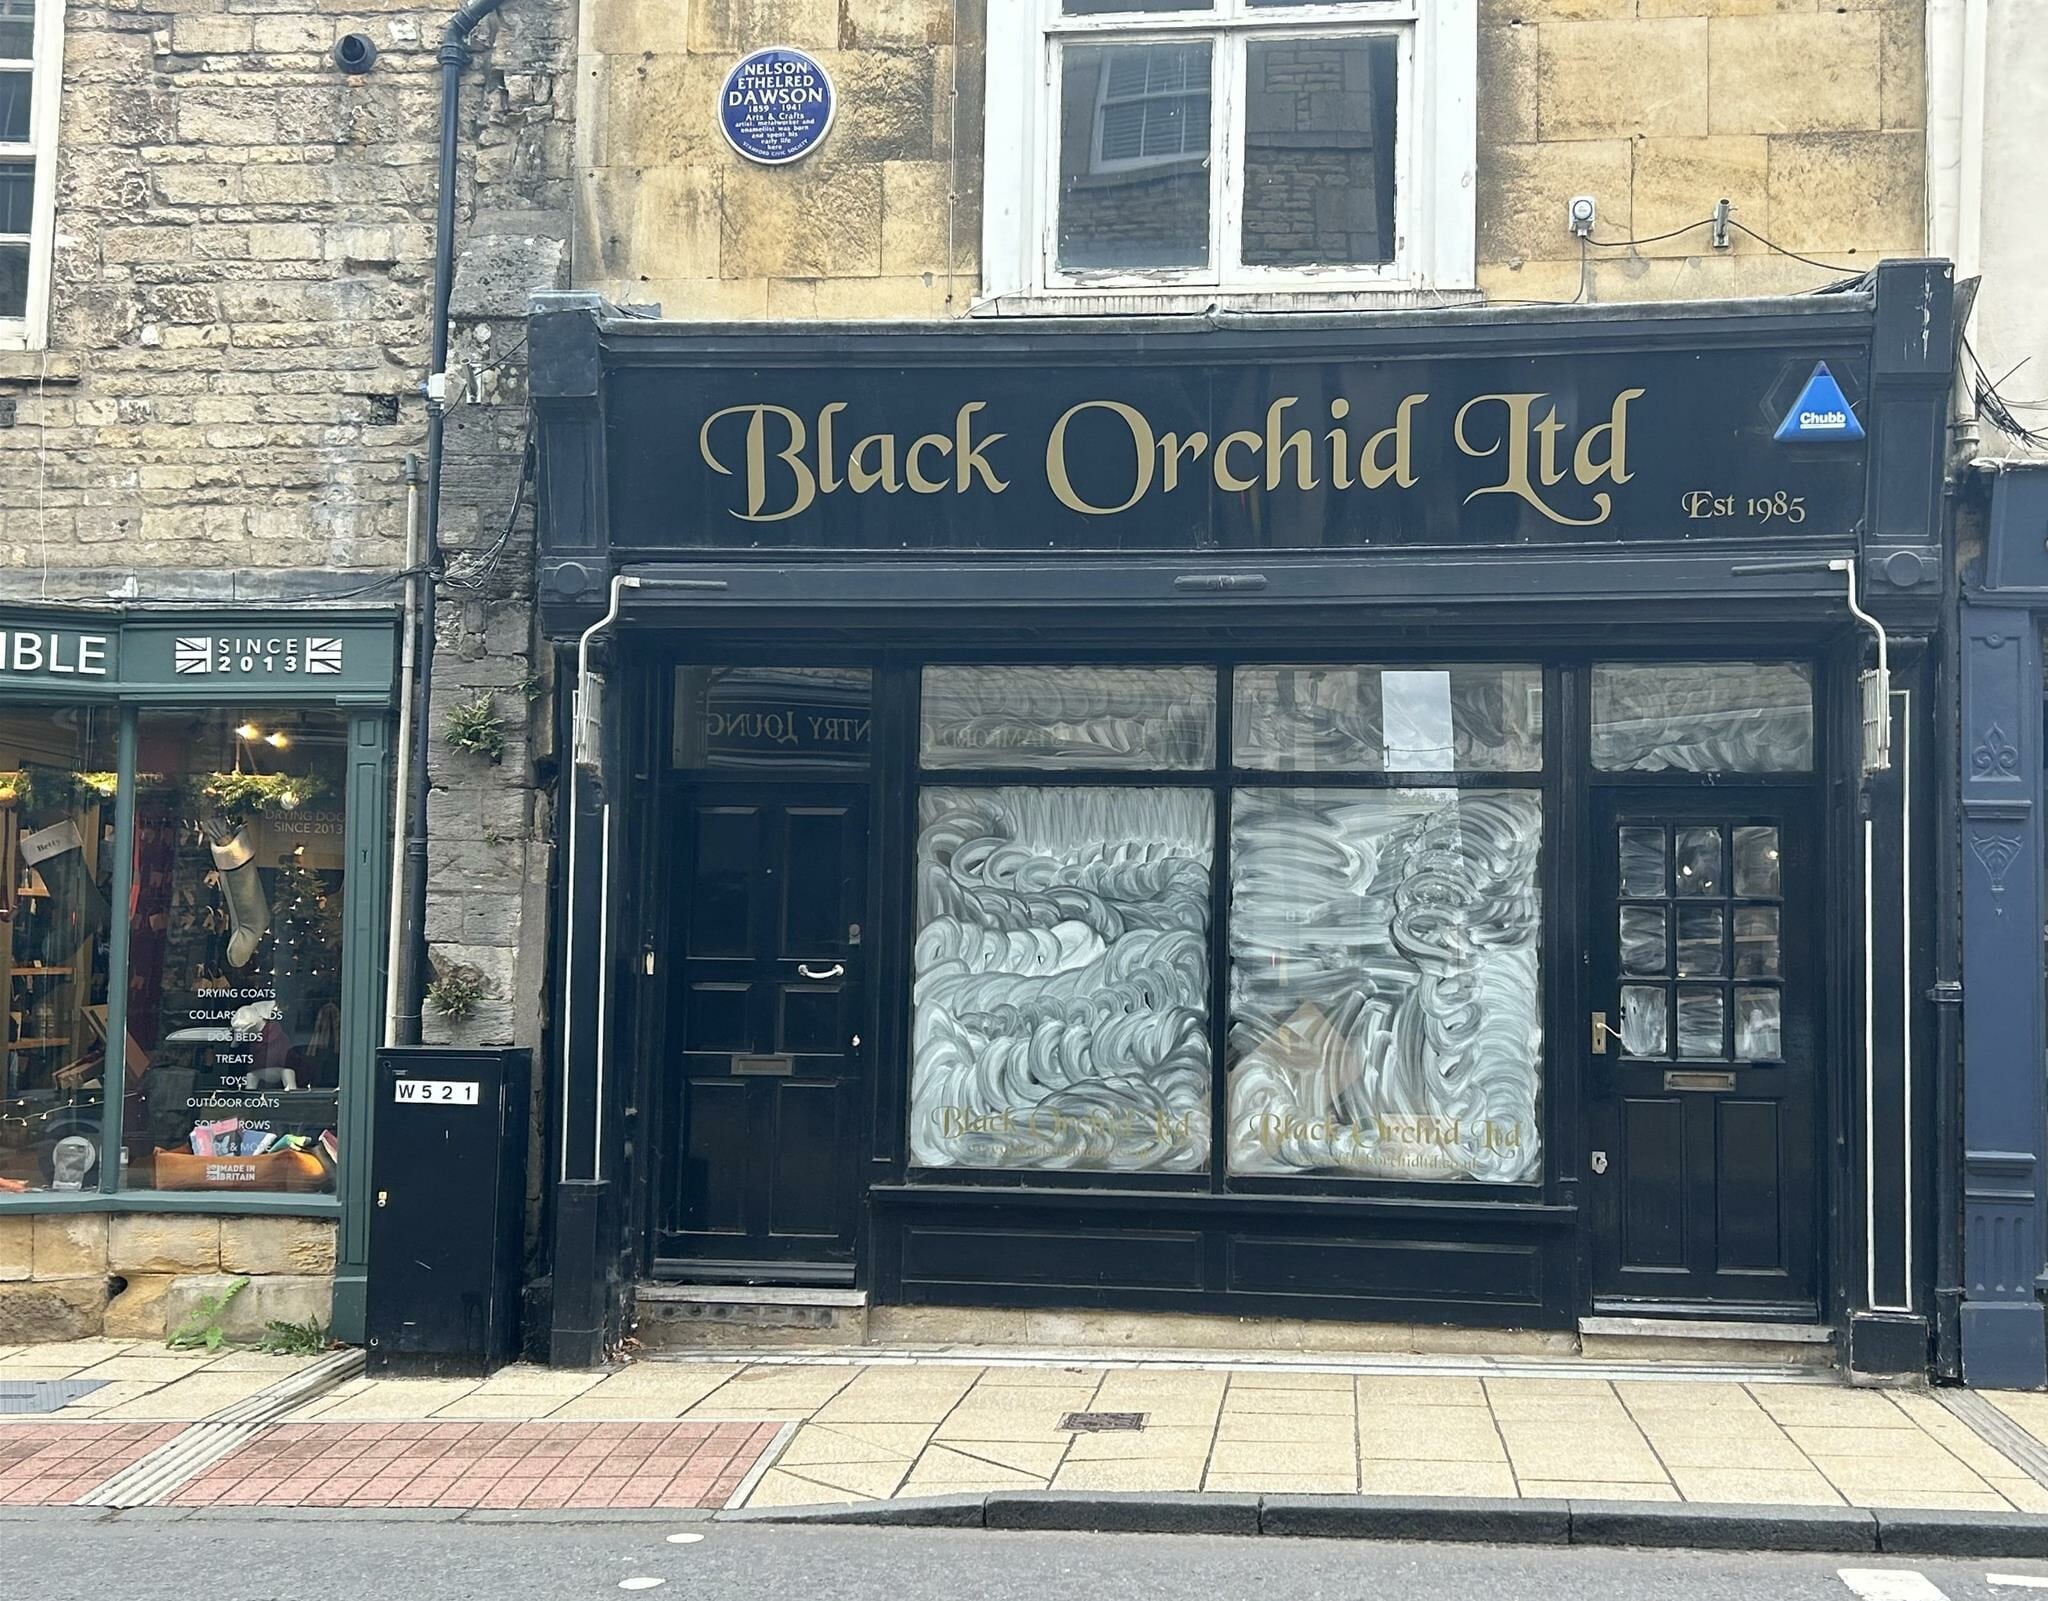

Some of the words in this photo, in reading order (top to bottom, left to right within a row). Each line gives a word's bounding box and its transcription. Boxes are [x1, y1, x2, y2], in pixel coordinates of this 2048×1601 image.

[744, 62, 808, 76] NELSON
[737, 75, 814, 90] ETHELRED
[729, 87, 823, 107] DAWSON
[748, 104, 770, 113] 1859
[781, 103, 801, 111] 1941
[745, 113, 764, 121] Arts
[768, 113, 776, 121] &
[779, 111, 805, 120] Crafts
[802, 117, 815, 125] and
[1800, 411, 1846, 424] Chubb
[700, 401, 1011, 522] Black
[1045, 393, 1430, 516] Orchid
[1453, 388, 1646, 526] Ltd
[1681, 490, 1735, 518] Est
[1747, 490, 1806, 525] 1985
[218, 638, 298, 654] SINCE
[0, 631, 107, 675] BLE
[218, 655, 298, 672] 2013
[273, 820, 312, 833] SINCE
[314, 822, 344, 834] 2013
[197, 988, 238, 998] DRYING
[240, 988, 276, 998] COATS
[188, 1010, 236, 1020] COLLARS
[207, 1031, 233, 1042] DOG
[236, 1032, 263, 1042] BEDS
[216, 1054, 254, 1064] TREATS
[220, 1076, 247, 1086] TOYS
[186, 1097, 242, 1108] OUTDOOR
[244, 1098, 280, 1108] COATS
[931, 1105, 1017, 1139] Black
[1249, 1112, 1340, 1148] Black
[1353, 1115, 1461, 1149] Orchid
[220, 1164, 243, 1173] MADE
[246, 1164, 256, 1172] IN
[220, 1172, 256, 1181] BRITAIN
